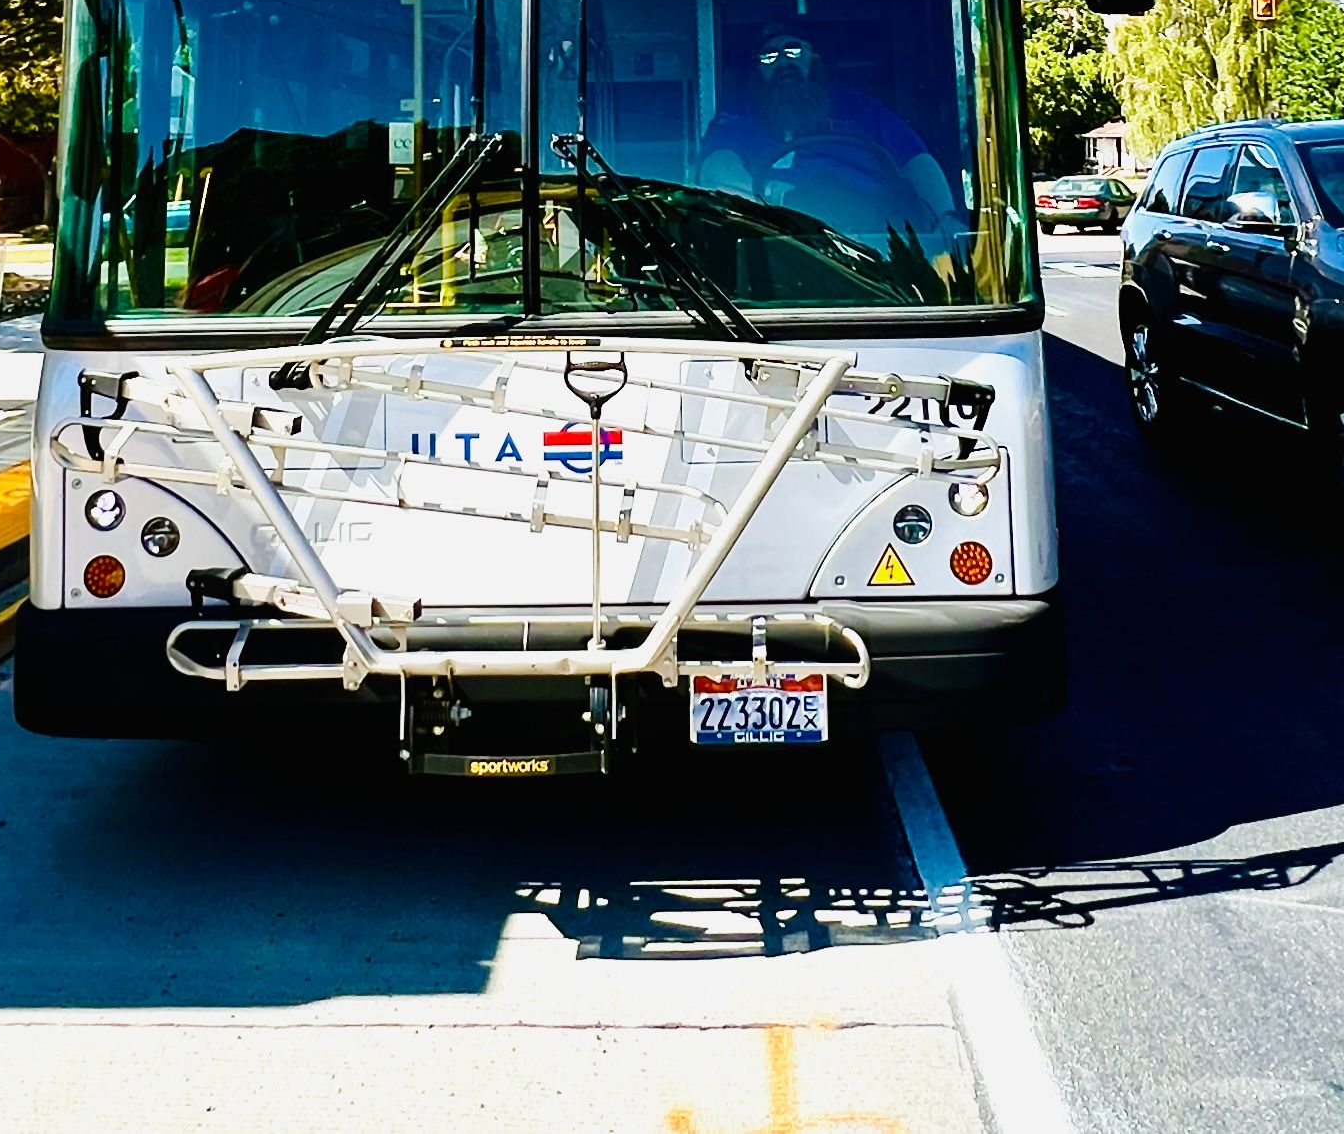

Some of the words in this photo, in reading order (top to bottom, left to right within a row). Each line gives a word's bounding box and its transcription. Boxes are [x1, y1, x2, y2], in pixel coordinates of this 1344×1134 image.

[411, 432, 523, 463] UTA
[700, 696, 801, 731] 223302
[470, 758, 549, 776] sportworks
